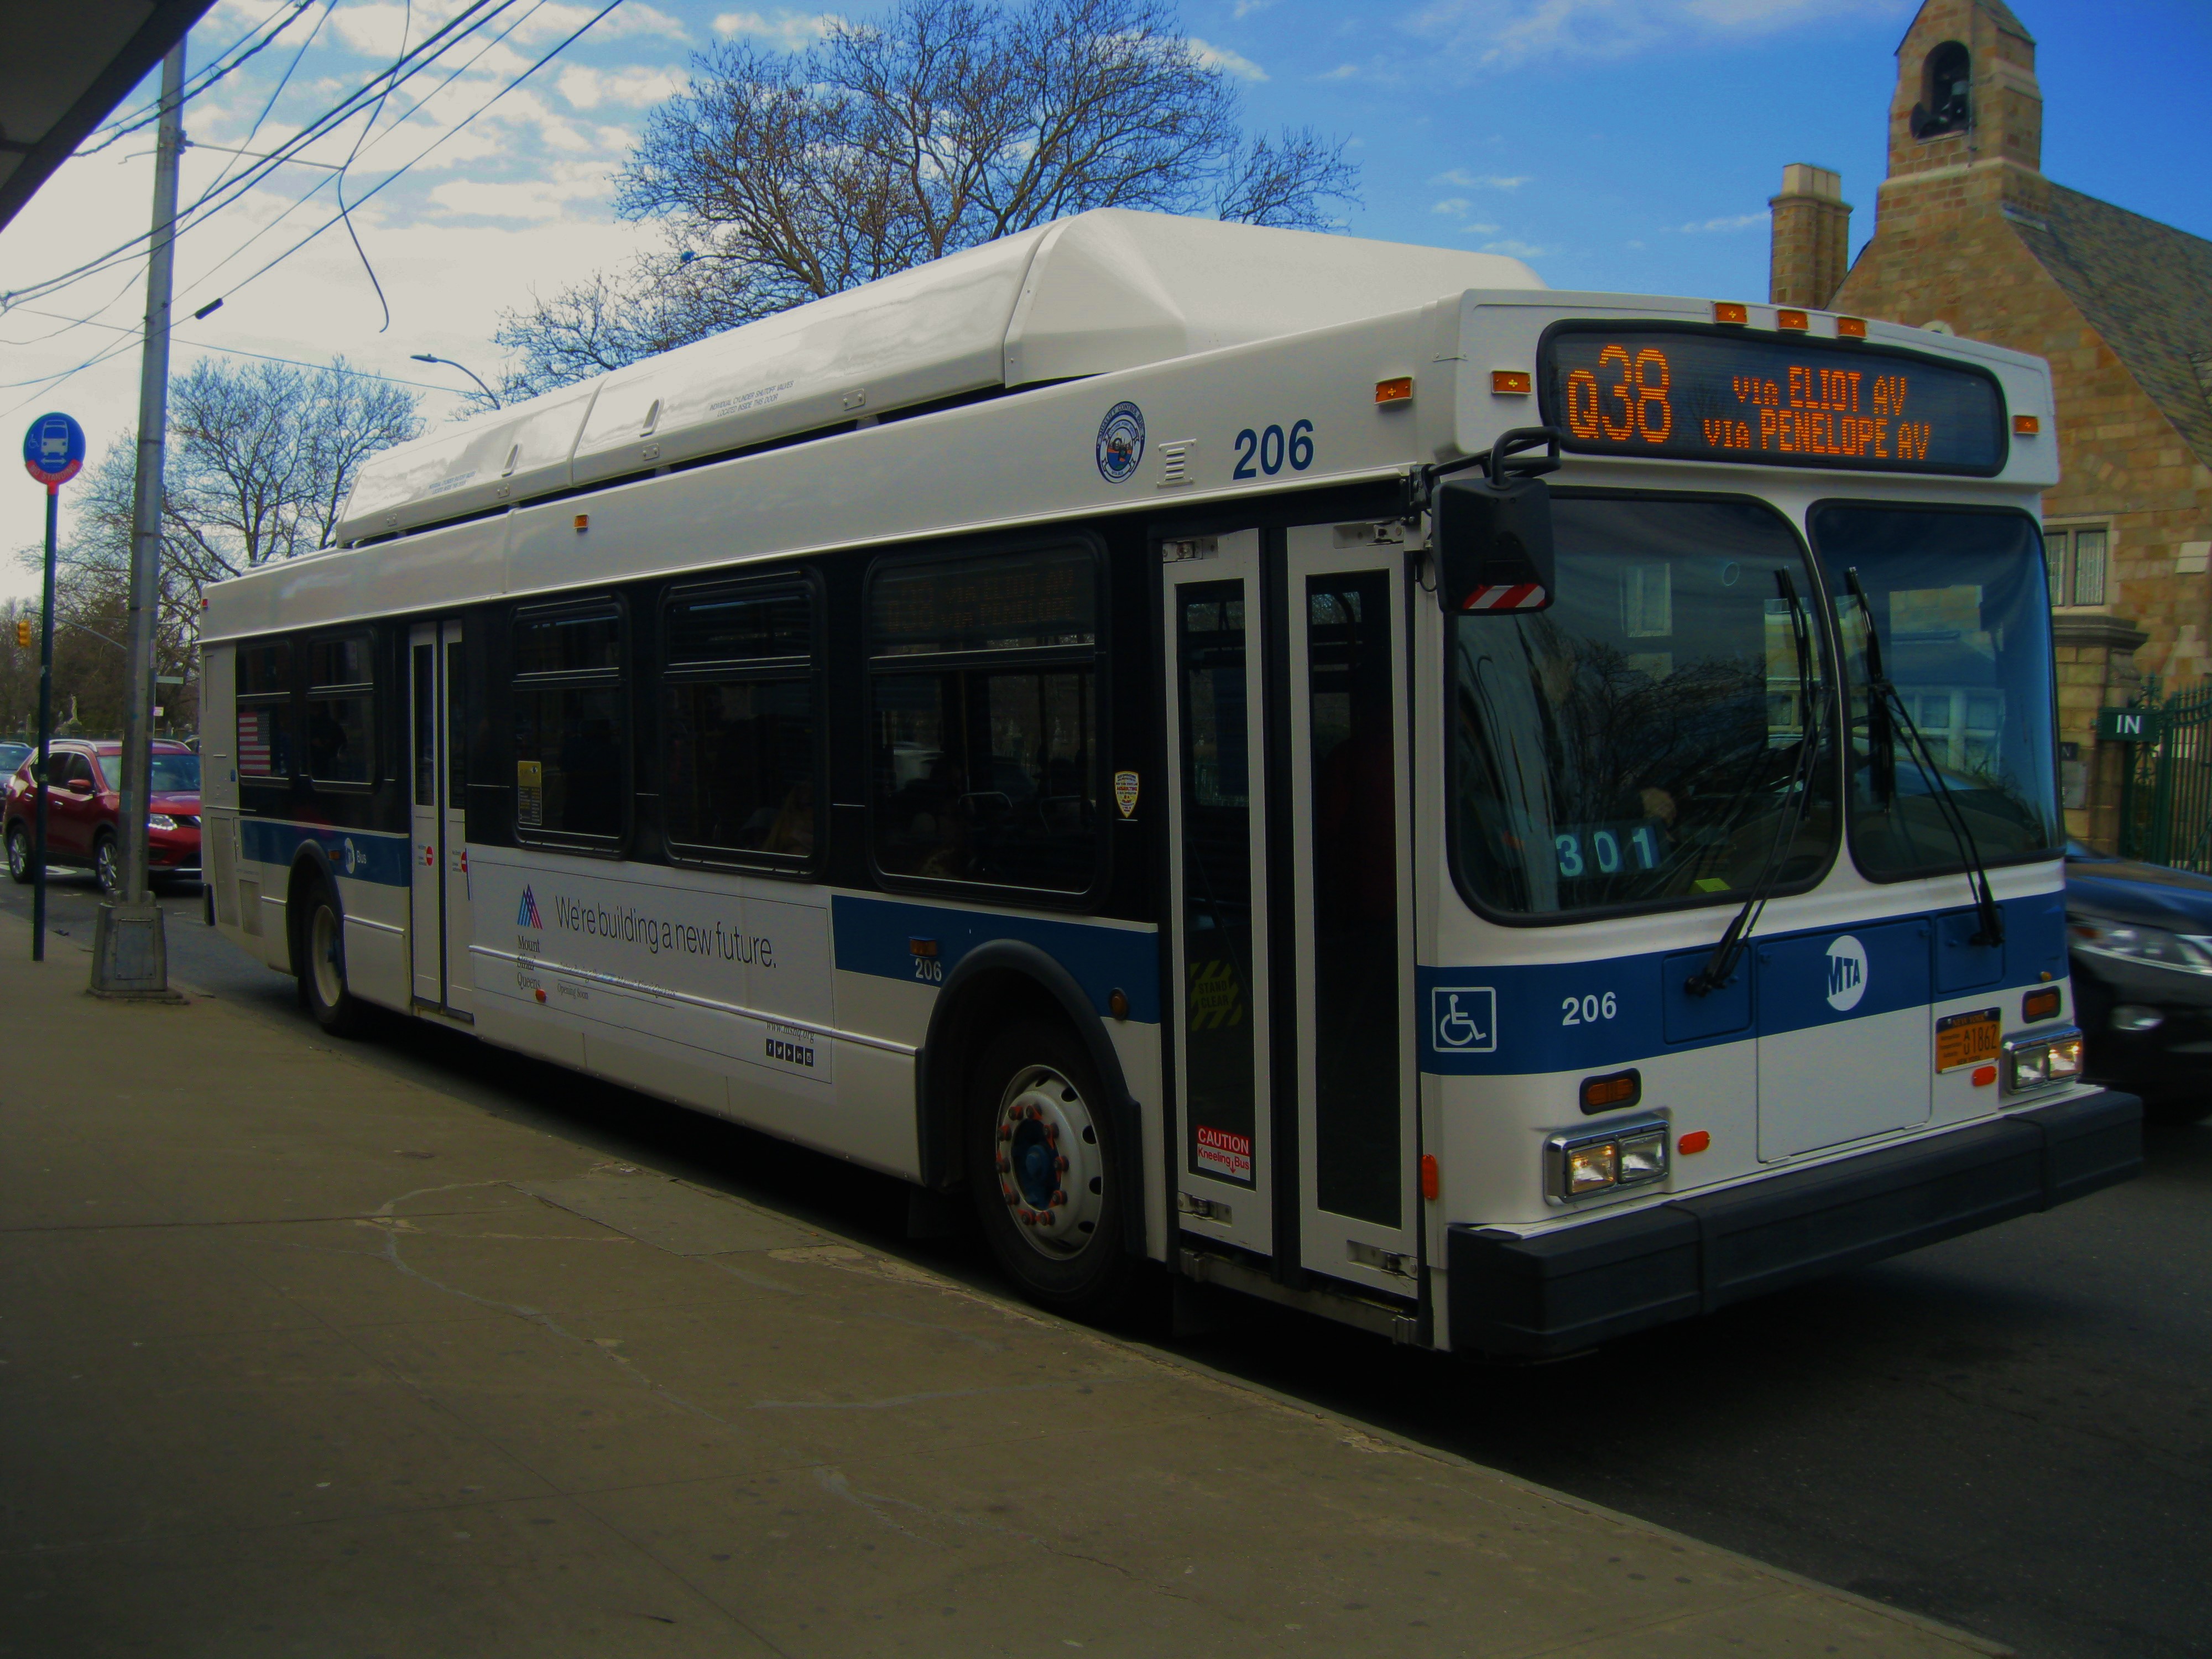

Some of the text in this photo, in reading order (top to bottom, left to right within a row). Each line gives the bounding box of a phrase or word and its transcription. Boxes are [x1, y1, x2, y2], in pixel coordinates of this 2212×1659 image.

[1568, 345, 1672, 443] Q38
[1733, 366, 1907, 416] VIA ELIOT AV
[1099, 408, 1117, 437] QUALITY
[1118, 403, 1137, 415] CONTROL
[1704, 408, 1931, 460] VIA PENELOPE AV
[1233, 419, 1313, 480] 206
[2116, 714, 2142, 734] IN
[356, 849, 367, 864] Bus
[518, 935, 540, 953] Mount
[555, 895, 777, 968] We're building a new future.
[517, 972, 541, 990] Queens
[915, 957, 942, 982] 206
[1825, 954, 1861, 998] MTA
[1198, 980, 1227, 994] STAND
[1201, 995, 1229, 1009] CLEAR
[1562, 991, 1617, 1026] 206
[1198, 1128, 1249, 1155] CAUTION
[1198, 1146, 1250, 1170] Kneeling Bus
